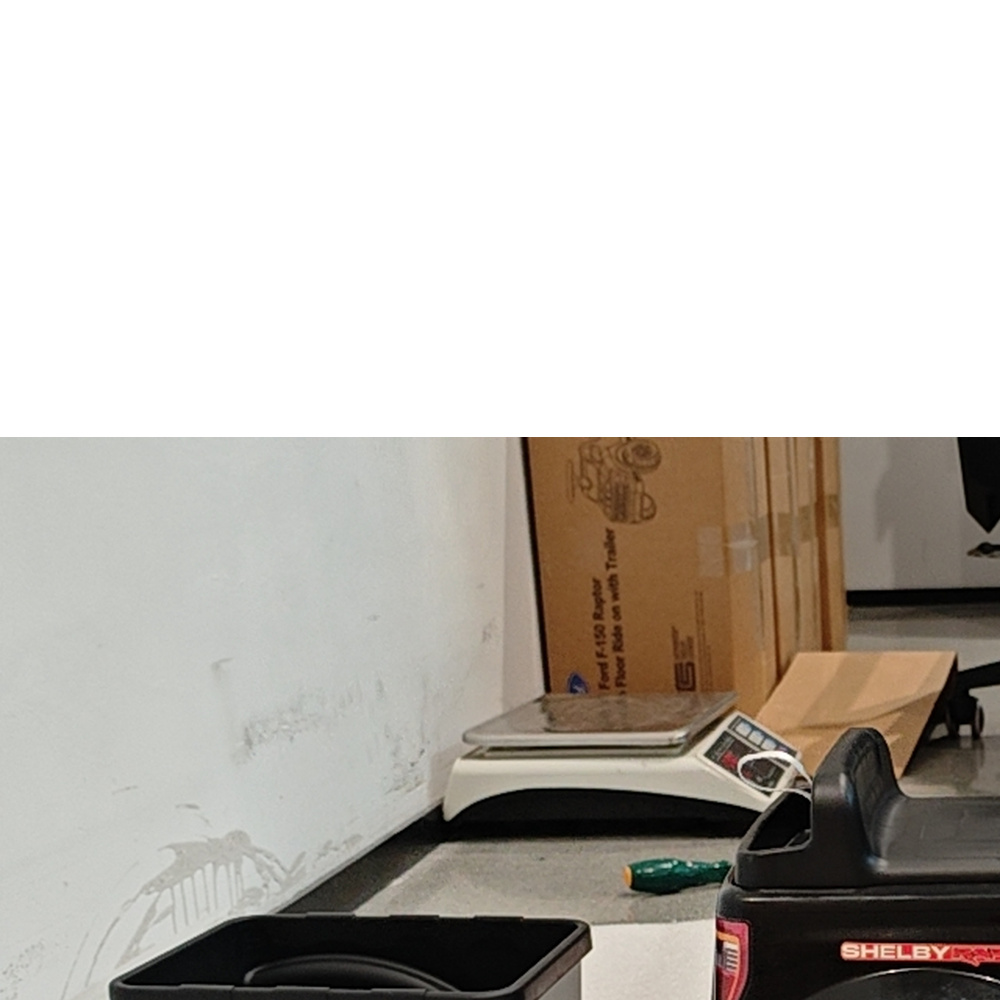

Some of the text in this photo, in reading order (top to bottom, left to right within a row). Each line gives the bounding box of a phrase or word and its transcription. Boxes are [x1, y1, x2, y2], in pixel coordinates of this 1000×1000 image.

[604, 527, 618, 571] Trailer
[607, 573, 620, 602] with
[611, 605, 622, 622] on
[592, 577, 610, 690] Ford F-150 Raptor
[612, 624, 625, 652] Ride
[615, 656, 627, 688] Floor
[841, 943, 951, 961] SHELBY
